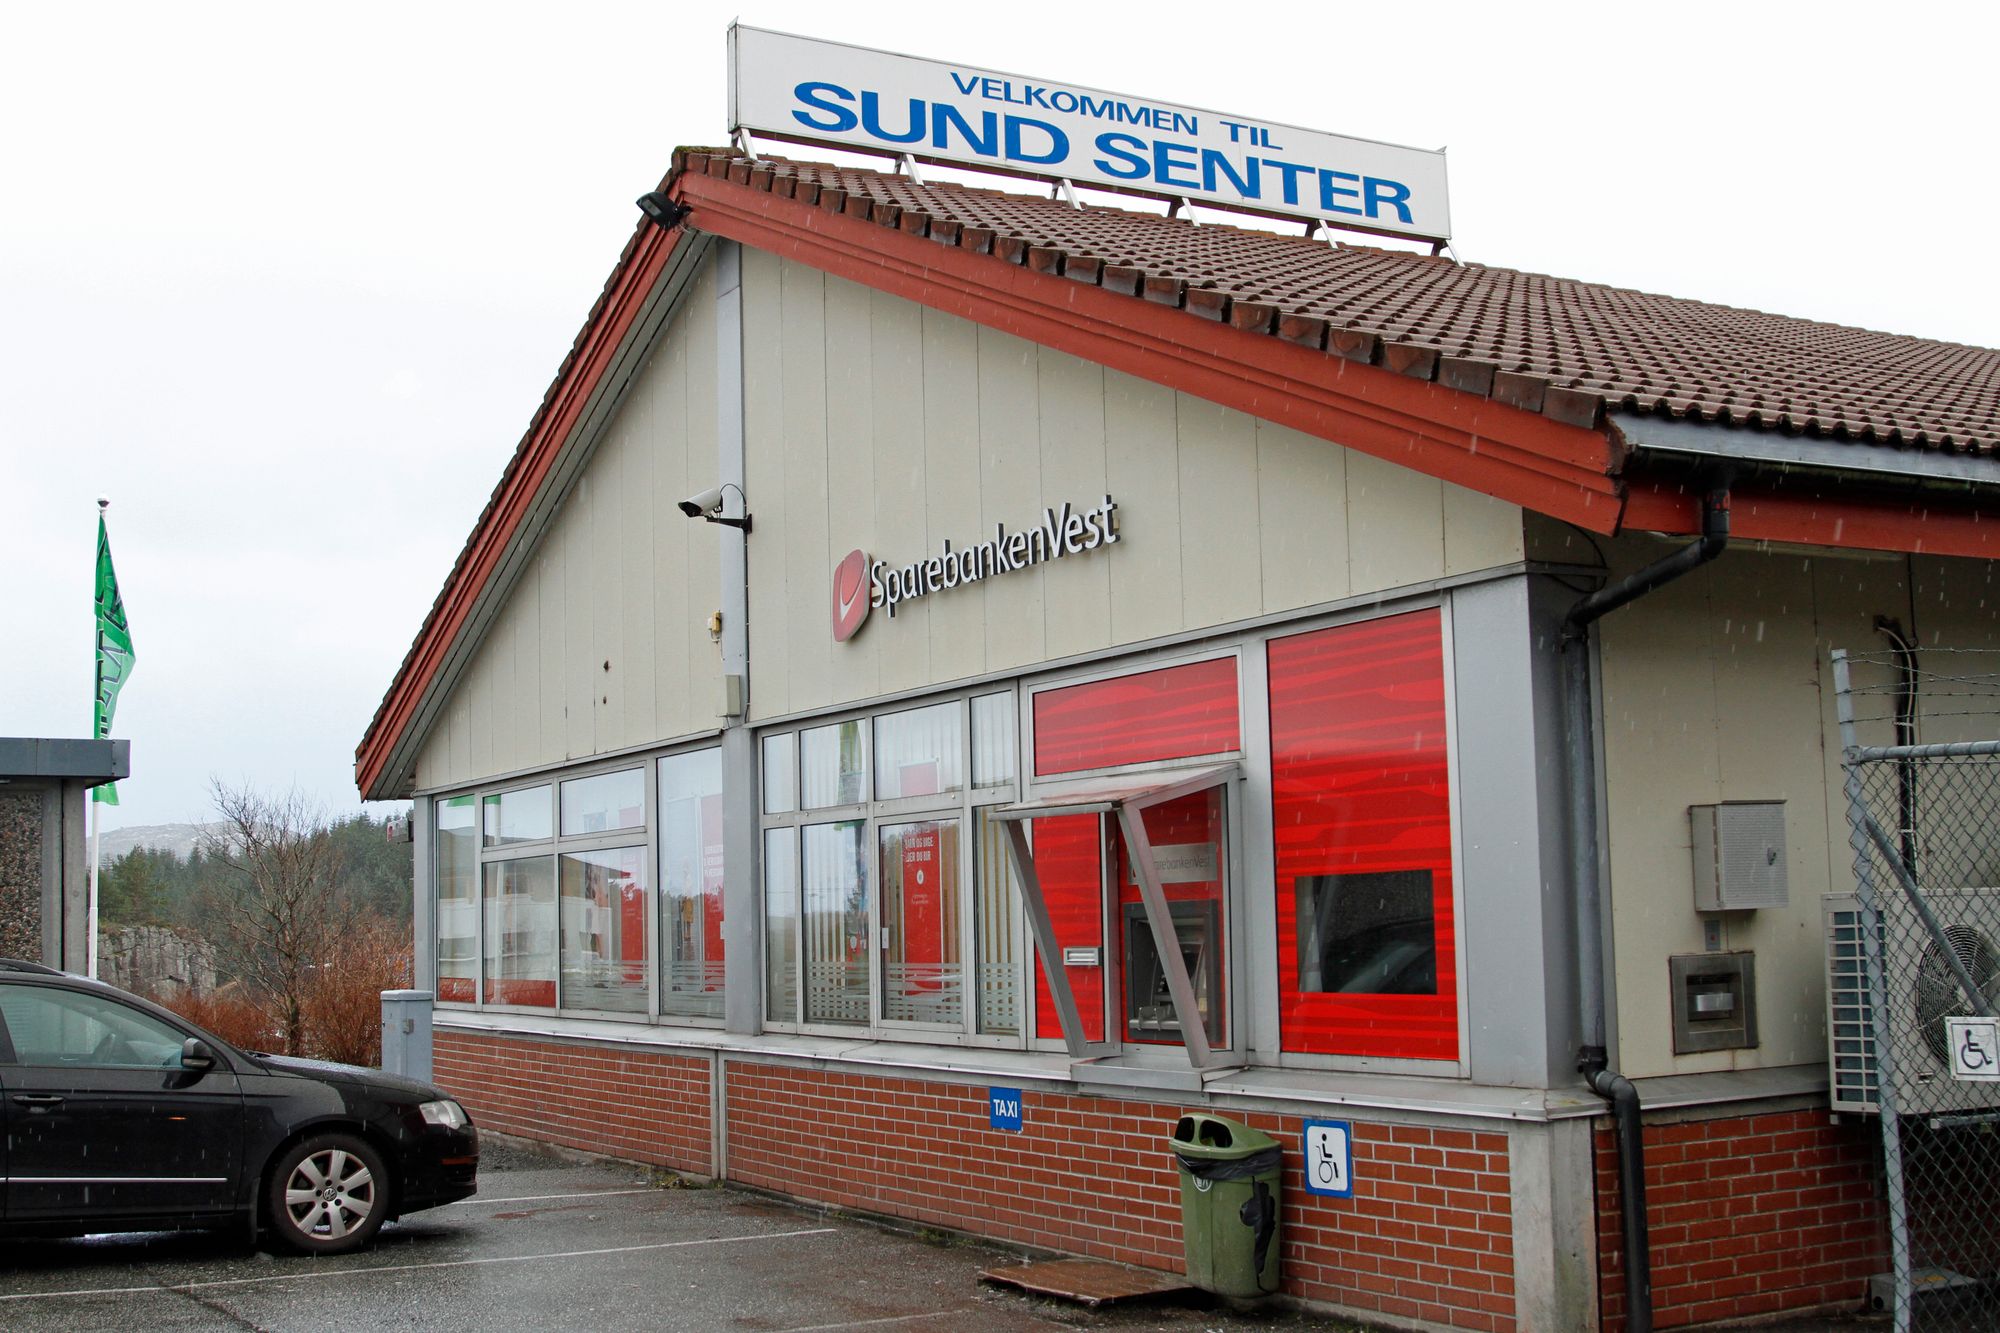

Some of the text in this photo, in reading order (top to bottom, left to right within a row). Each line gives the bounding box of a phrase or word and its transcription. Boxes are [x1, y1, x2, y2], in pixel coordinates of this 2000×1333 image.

[791, 81, 1414, 224] SUND SENTER
[951, 72, 1283, 150] VELKOMMEN TIL
[871, 494, 1120, 618] SparebankenVest
[993, 1099, 1018, 1118] TAXI
